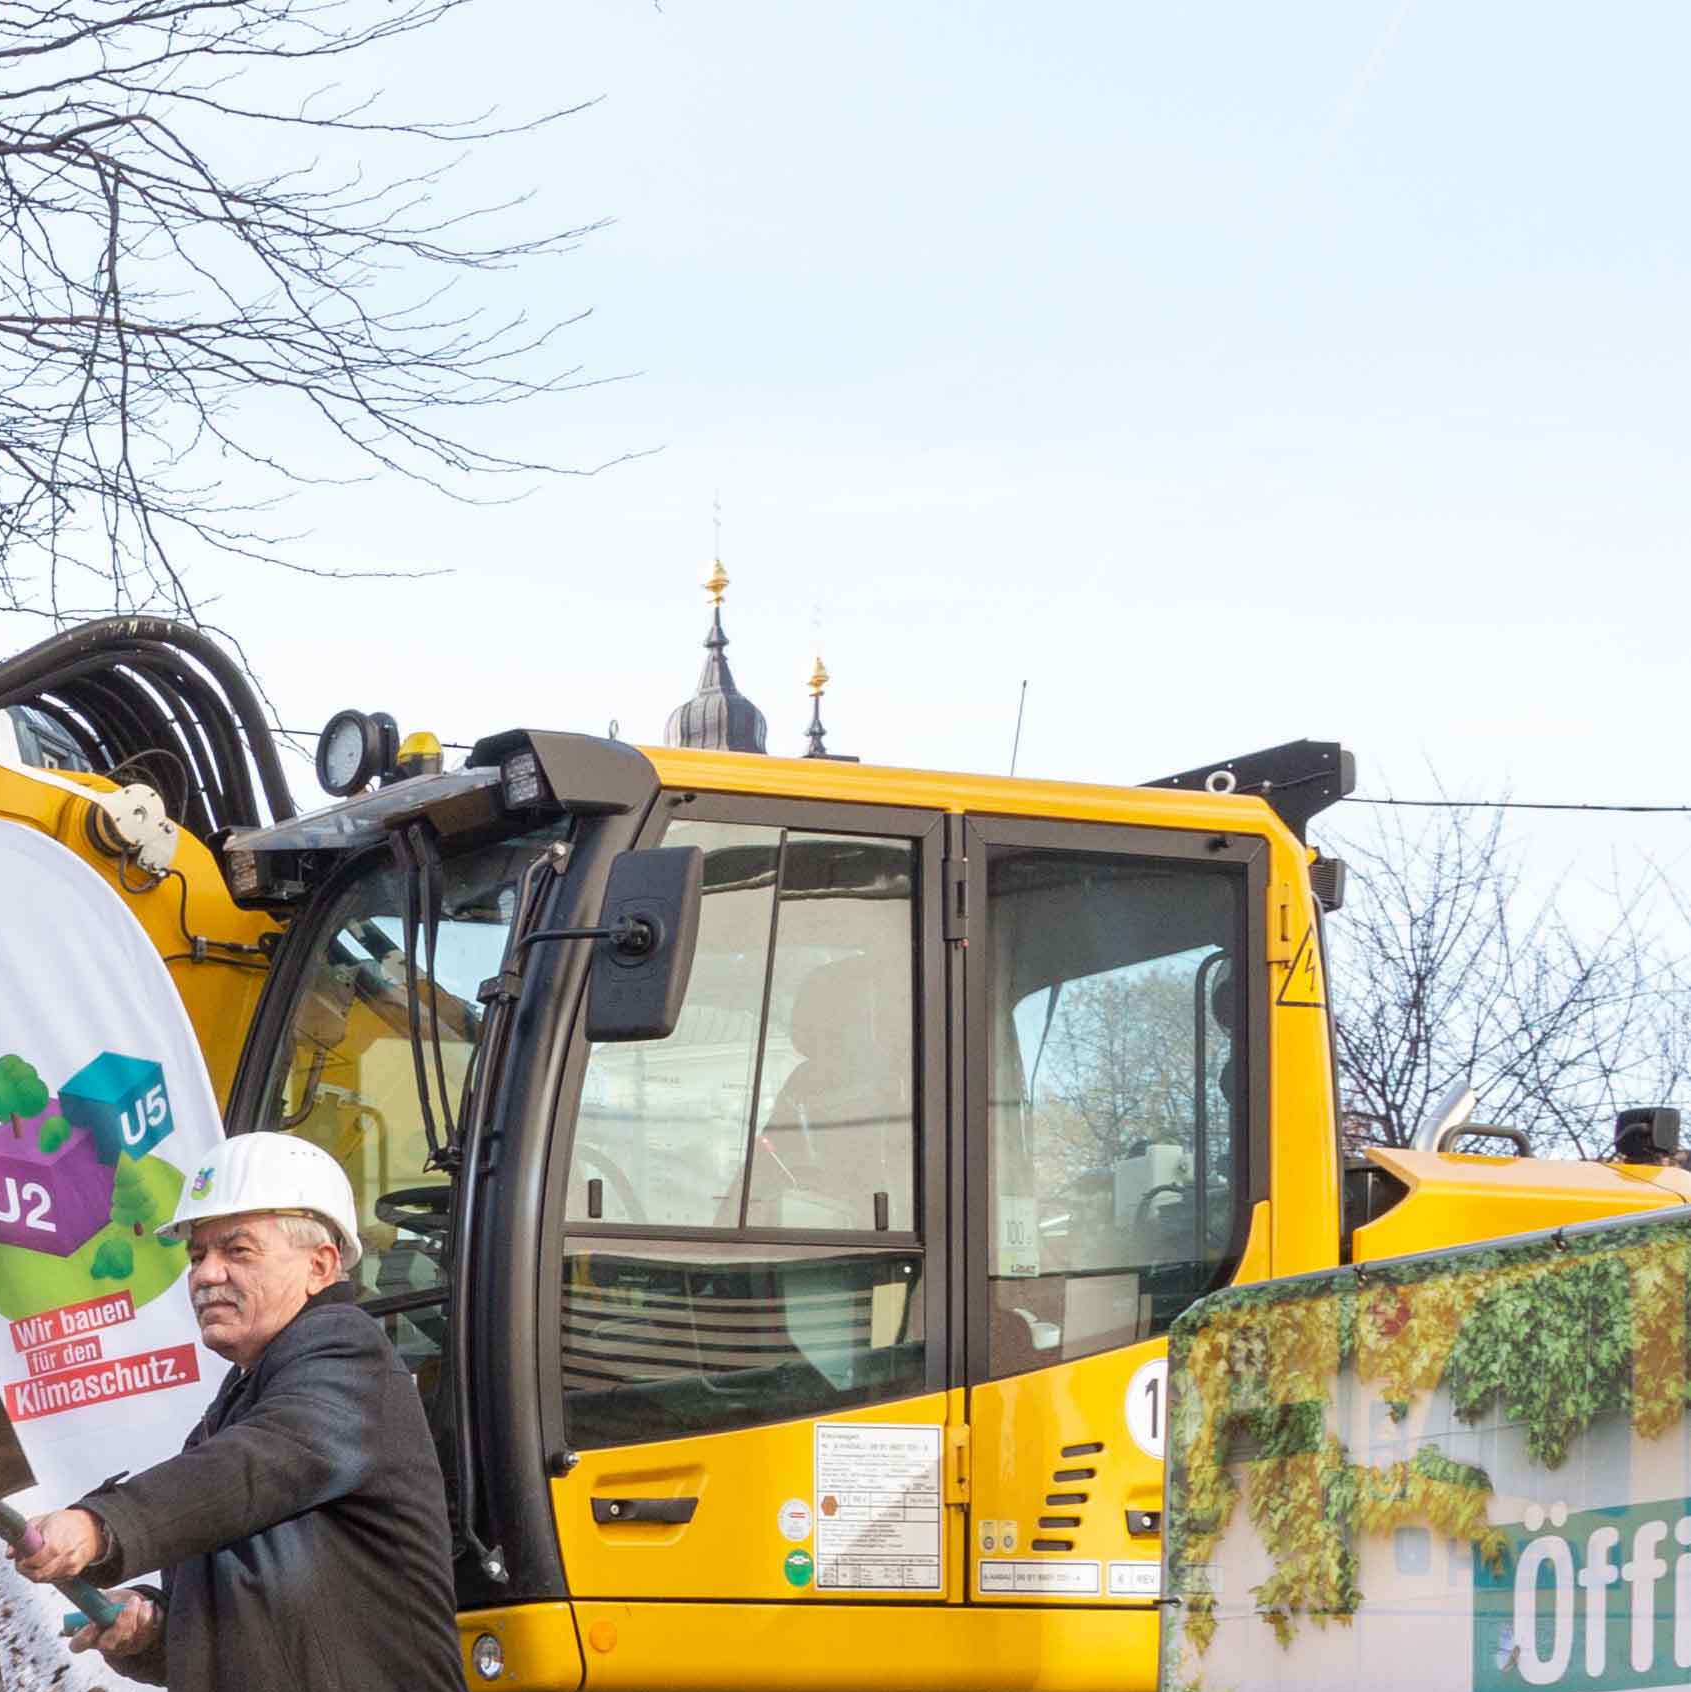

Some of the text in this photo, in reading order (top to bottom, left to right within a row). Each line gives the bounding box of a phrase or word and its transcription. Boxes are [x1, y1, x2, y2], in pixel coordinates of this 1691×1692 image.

[120, 1084, 167, 1145] U5
[15, 1299, 130, 1348] Wir bauen
[32, 1342, 98, 1374] für den
[15, 1356, 187, 1416] Klimaschutz.
